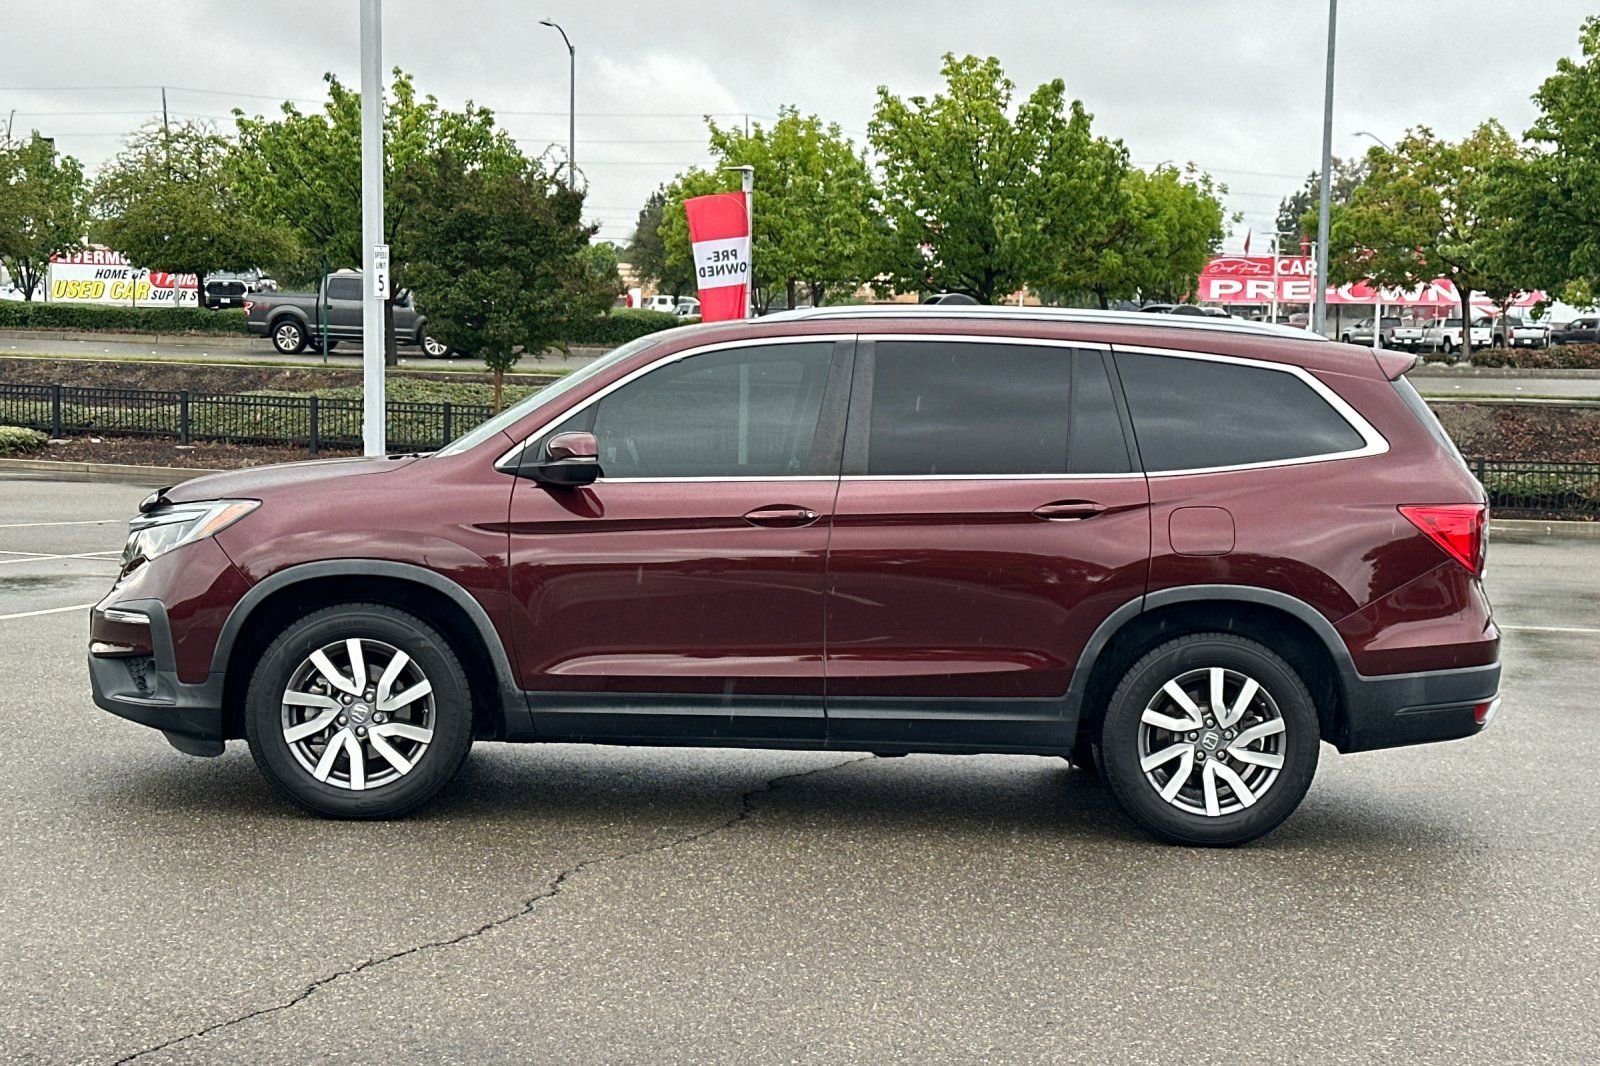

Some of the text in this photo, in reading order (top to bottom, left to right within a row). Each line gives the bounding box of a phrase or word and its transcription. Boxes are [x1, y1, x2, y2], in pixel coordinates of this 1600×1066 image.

[95, 269, 129, 279] HOME
[53, 280, 151, 300] USED CAR
[378, 274, 385, 292] 5
[151, 290, 187, 301] SUPR
